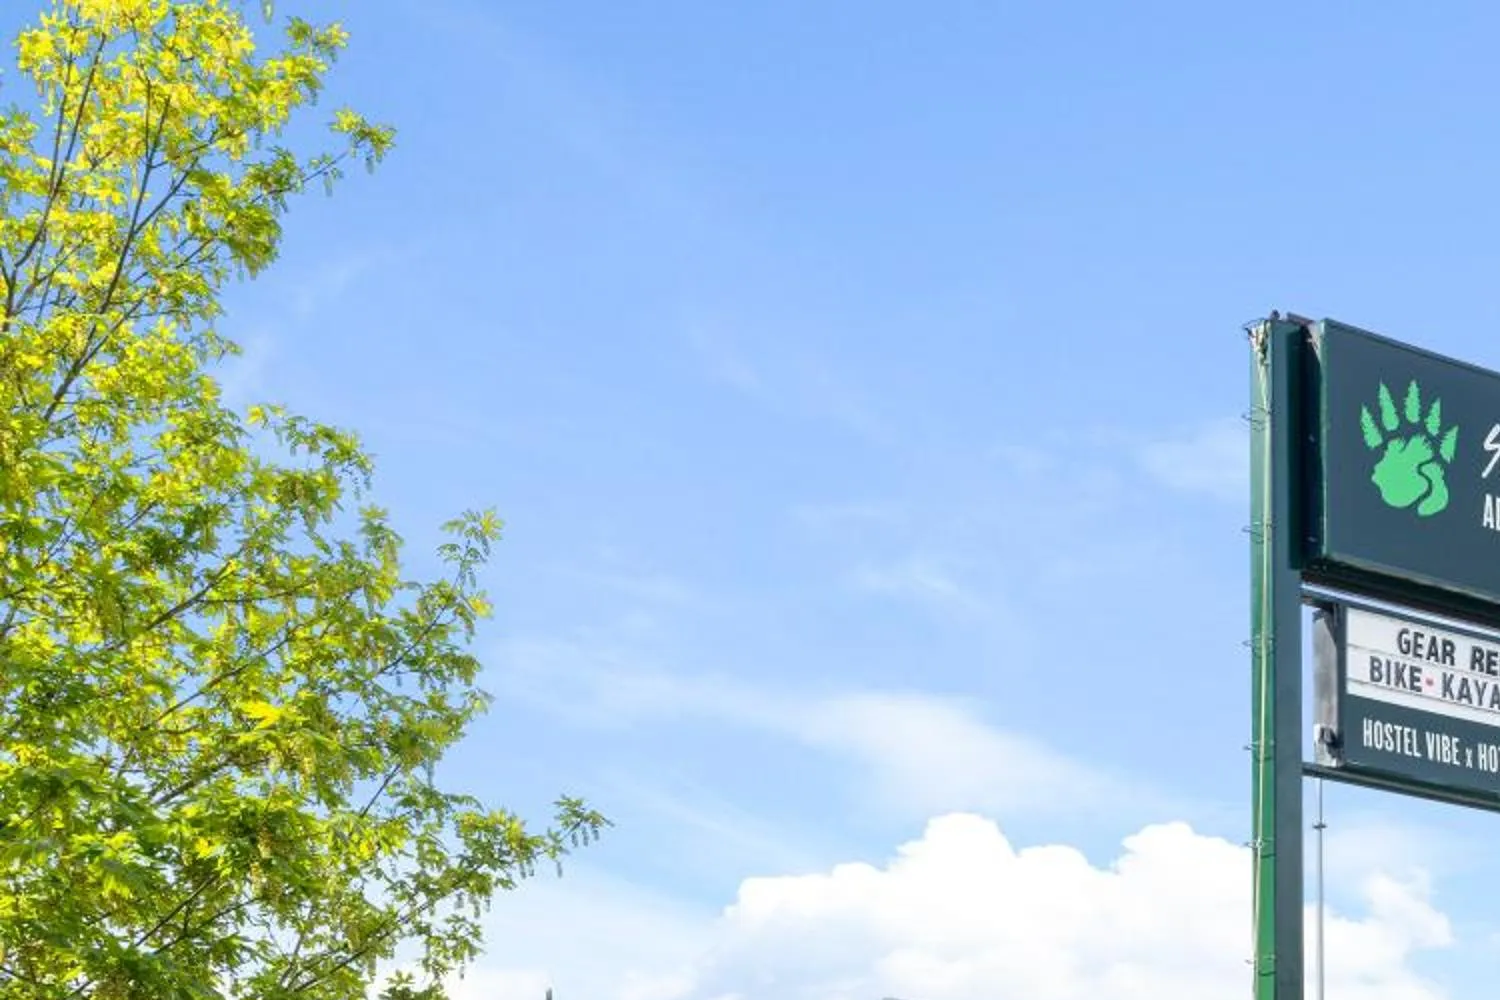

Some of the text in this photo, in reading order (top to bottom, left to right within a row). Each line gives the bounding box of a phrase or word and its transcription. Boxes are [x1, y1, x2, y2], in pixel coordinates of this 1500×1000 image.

[1397, 628, 1455, 666] GEAR
[1369, 656, 1423, 693] BIKE
[1363, 718, 1421, 757] HOSTEL
[1425, 731, 1460, 765] VIBE
